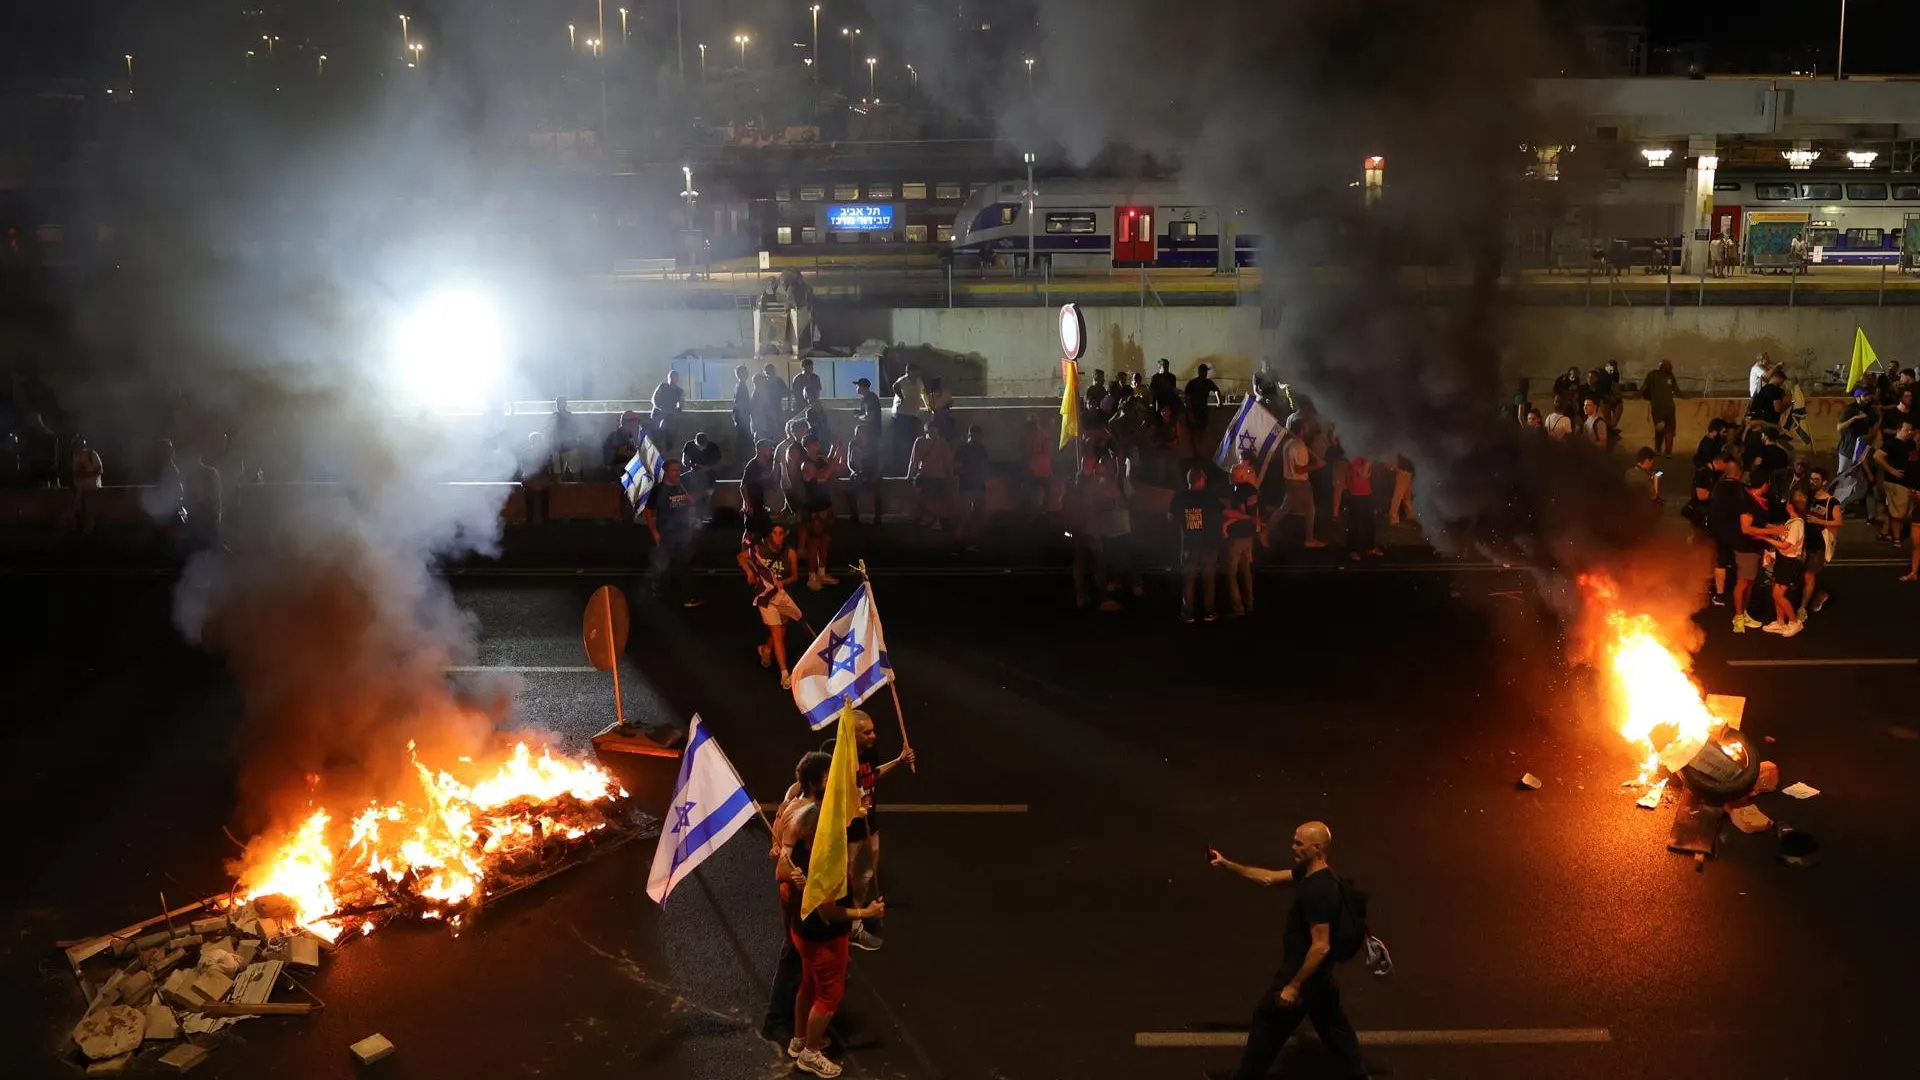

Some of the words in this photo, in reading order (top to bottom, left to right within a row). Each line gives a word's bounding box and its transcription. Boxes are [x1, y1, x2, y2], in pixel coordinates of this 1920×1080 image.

[840, 207, 864, 216] אביב
[867, 206, 881, 216] תל
[831, 216, 856, 225] מרכז
